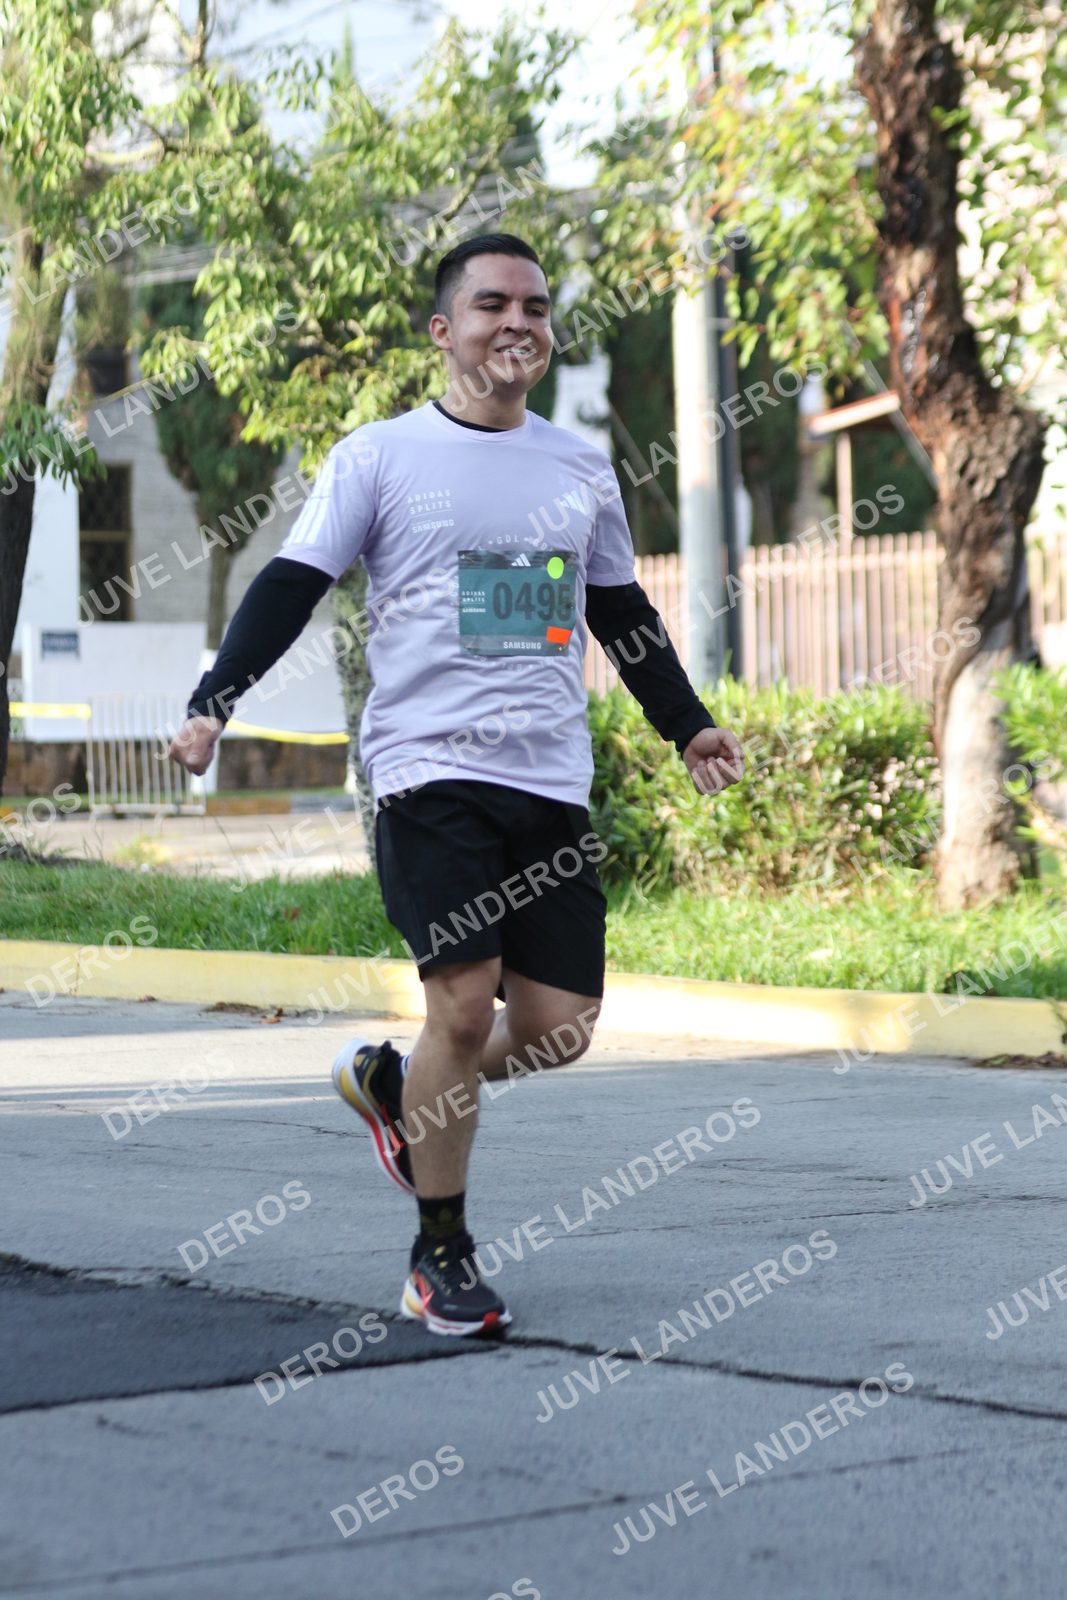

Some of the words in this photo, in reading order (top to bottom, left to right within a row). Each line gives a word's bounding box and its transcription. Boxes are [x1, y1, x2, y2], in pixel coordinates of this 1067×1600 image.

[406, 489, 451, 504] ADIDAS
[409, 500, 452, 515] SPLITS
[412, 519, 455, 533] SAMSUNG
[492, 581, 573, 622] 0495
[503, 641, 541, 650] SAMSUNG
